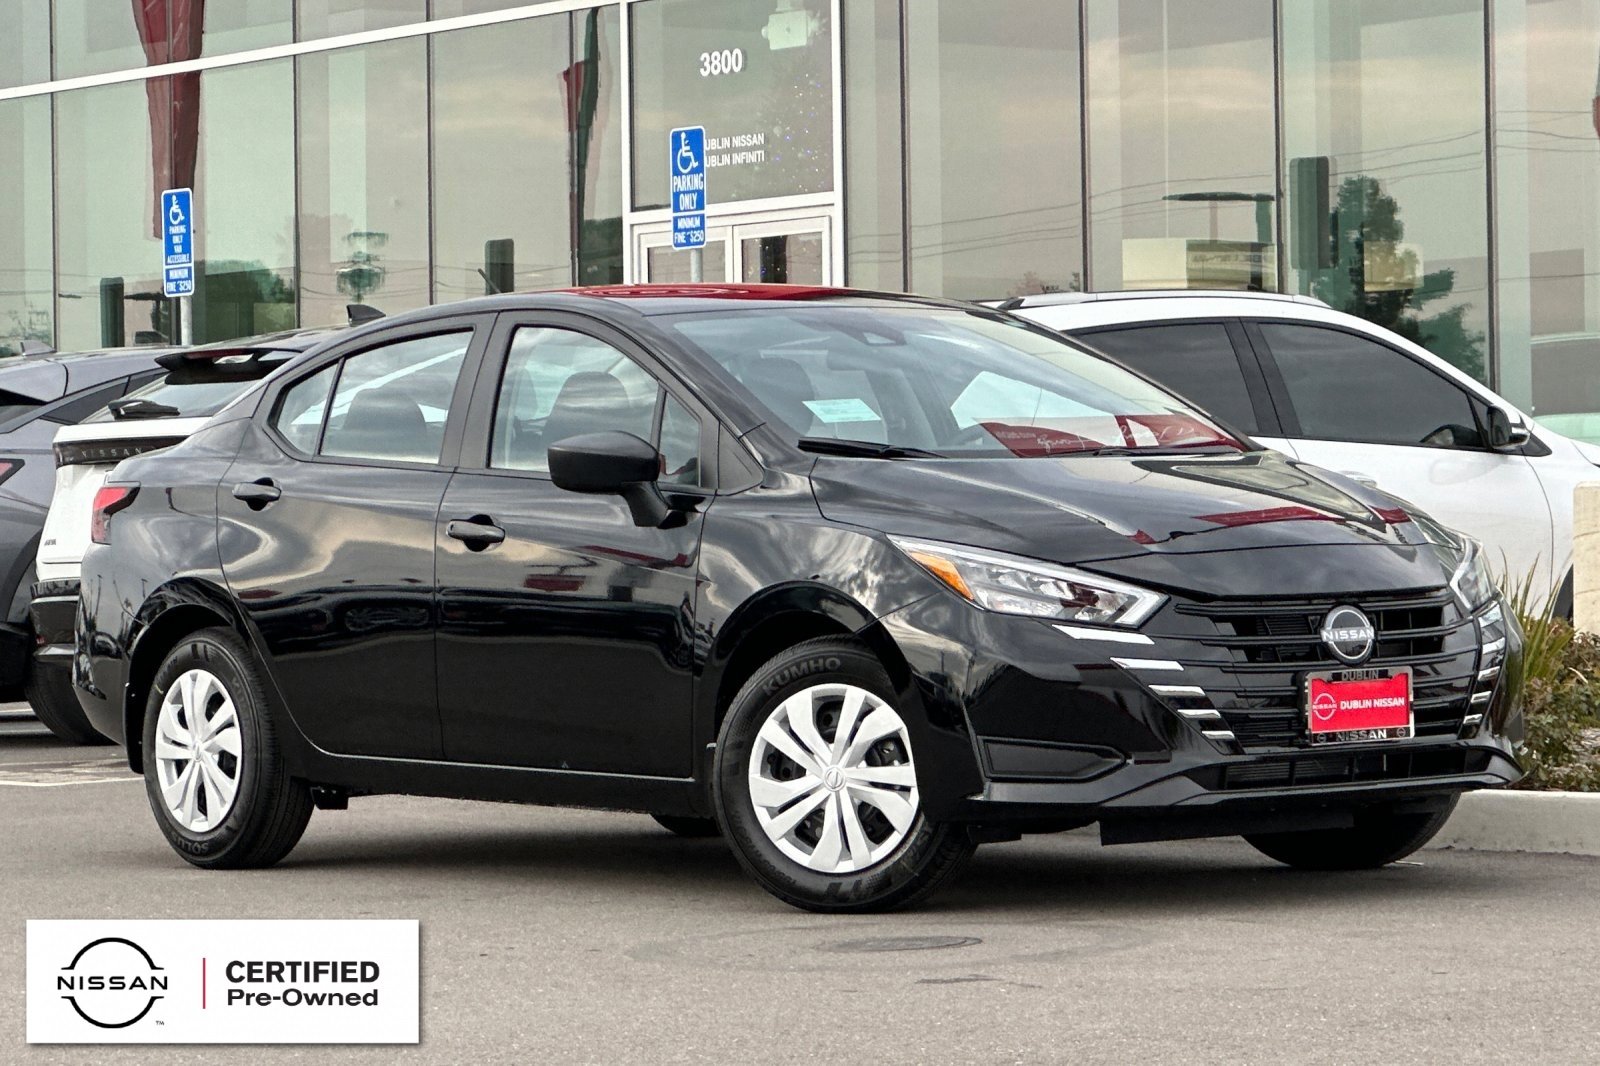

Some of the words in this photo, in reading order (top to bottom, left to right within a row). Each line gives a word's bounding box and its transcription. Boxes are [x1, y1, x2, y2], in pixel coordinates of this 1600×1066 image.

[700, 48, 742, 77] 3800
[705, 137, 731, 150] UBLIN
[732, 133, 765, 148] NISSAN
[705, 153, 731, 167] UBLIN
[732, 150, 765, 165] INFINITI
[673, 173, 704, 192] PARKING
[679, 193, 698, 210] ONLY
[677, 216, 701, 229] MINIMUM
[674, 231, 686, 244] FINE
[81, 447, 142, 459] NISSAN
[1322, 629, 1374, 640] NISSAN
[762, 657, 841, 696] KUMHO
[1341, 669, 1379, 680] DUBLIN
[1340, 699, 1372, 711] DUBLIN
[1373, 697, 1405, 708] NISSAN
[1336, 728, 1387, 743] NISSAN
